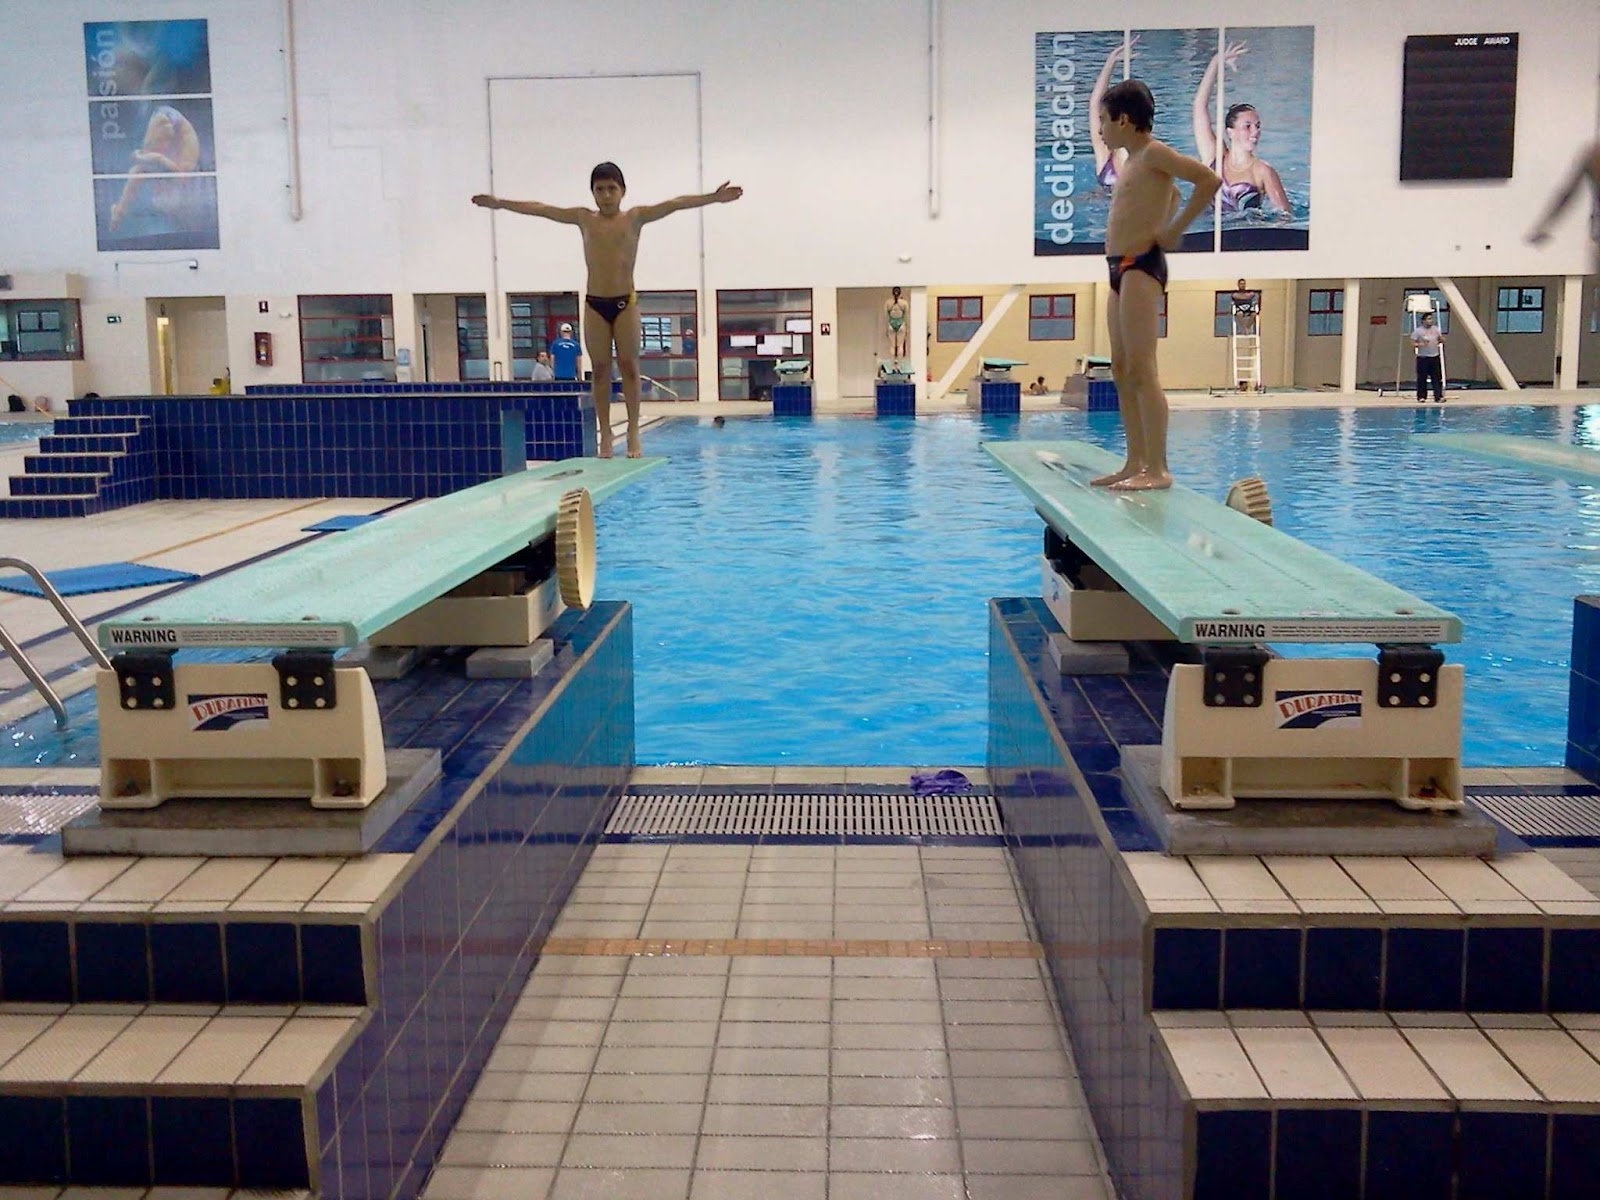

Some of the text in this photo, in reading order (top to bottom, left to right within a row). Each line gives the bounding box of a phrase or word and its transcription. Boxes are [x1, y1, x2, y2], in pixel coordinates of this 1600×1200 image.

[1454, 36, 1510, 46] JUDGE AWARD
[91, 30, 125, 139] pasión
[1043, 34, 1075, 245] dedicación
[112, 629, 176, 643] WARNING
[1195, 624, 1265, 638] WARNING
